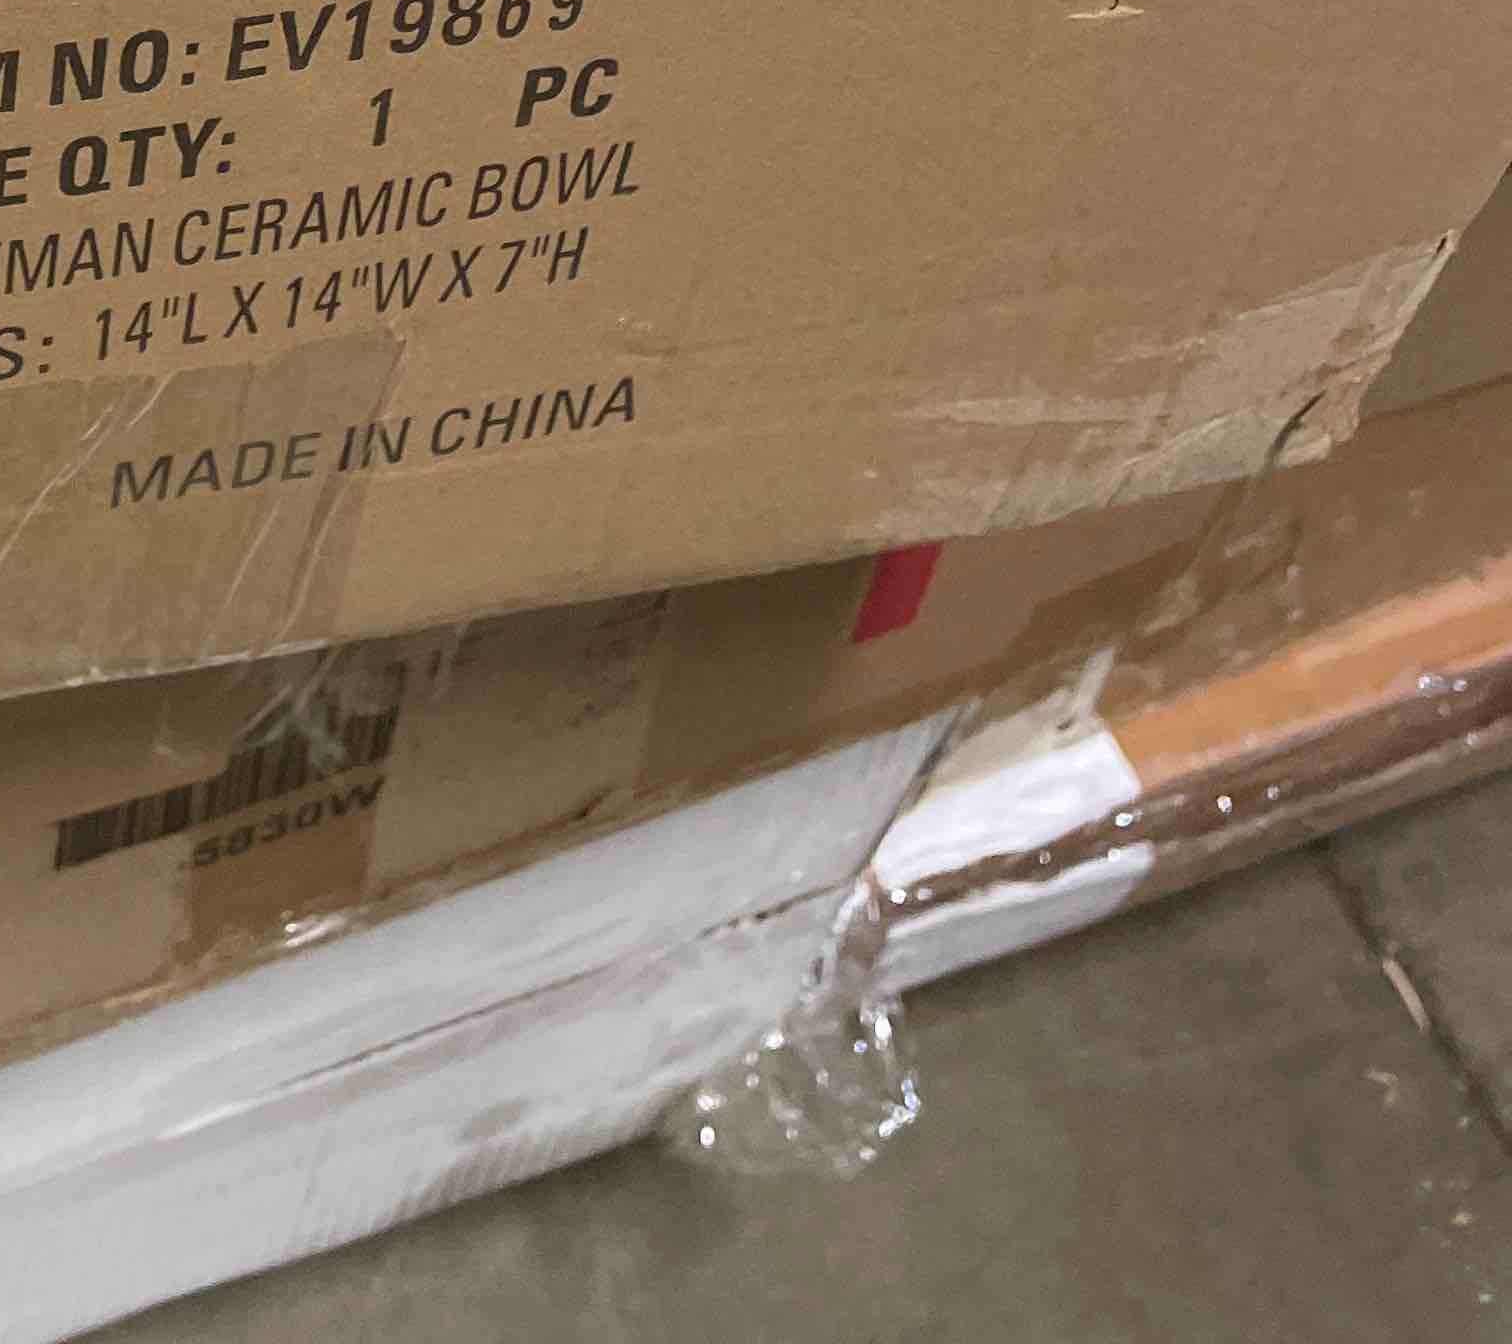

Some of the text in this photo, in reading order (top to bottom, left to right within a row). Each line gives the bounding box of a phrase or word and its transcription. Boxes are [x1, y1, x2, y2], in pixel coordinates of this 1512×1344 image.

[47, 26, 204, 104] NO:
[58, 118, 238, 200] QTY:
[367, 88, 396, 148] 1
[515, 57, 619, 127] PC
[171, 174, 453, 269] CERAMIC
[468, 140, 644, 221] BOWL
[95, 294, 211, 363] 14"L
[222, 280, 265, 342] X
[439, 242, 480, 302] X
[497, 227, 591, 291] 7"H
[110, 376, 638, 509] MADE IN CHINA
